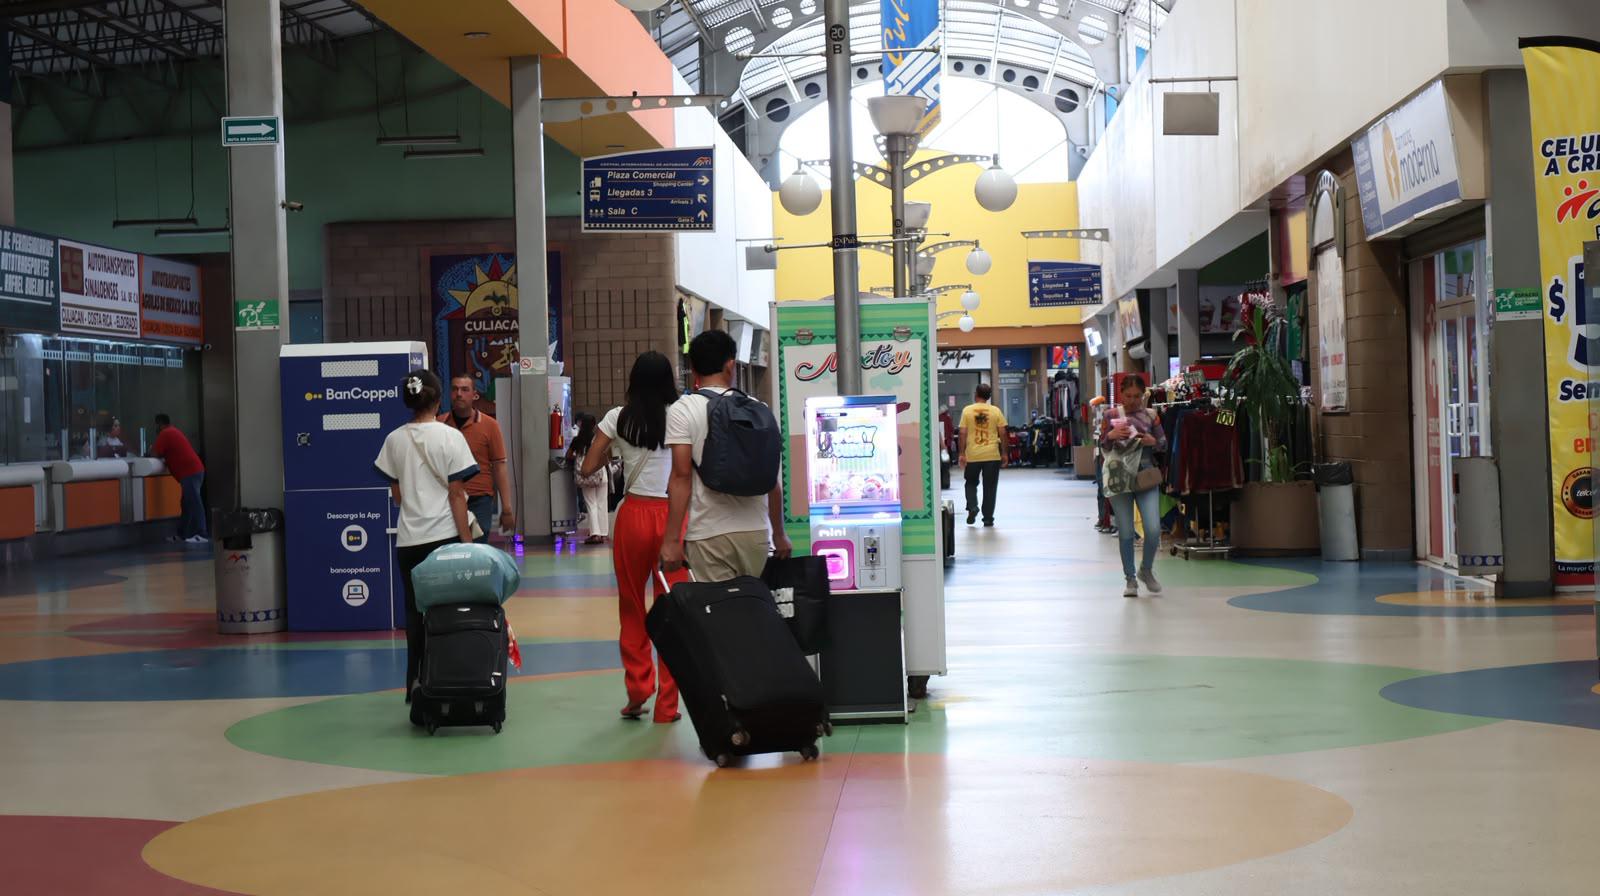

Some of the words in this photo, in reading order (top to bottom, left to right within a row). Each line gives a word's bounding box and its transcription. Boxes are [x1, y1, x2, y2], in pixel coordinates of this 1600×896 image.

[831, 27, 845, 39] 20
[833, 44, 842, 54] B
[1545, 158, 1560, 176] A
[607, 171, 630, 179] Plaza
[632, 171, 676, 179] Comercial
[607, 189, 645, 198] Llegadas
[607, 207, 626, 215] Sala
[631, 207, 638, 215] C
[87, 252, 135, 278] AUTOTRANSPORTES
[84, 278, 119, 301] SINALOENSES
[87, 311, 102, 326] COSTA
[102, 313, 112, 328] RICA
[465, 320, 520, 331] CULIACA
[326, 386, 399, 402] BanCoppel
[326, 512, 358, 520] Descarga
[818, 527, 847, 538] mini
[330, 566, 380, 574] bancoppel.com
